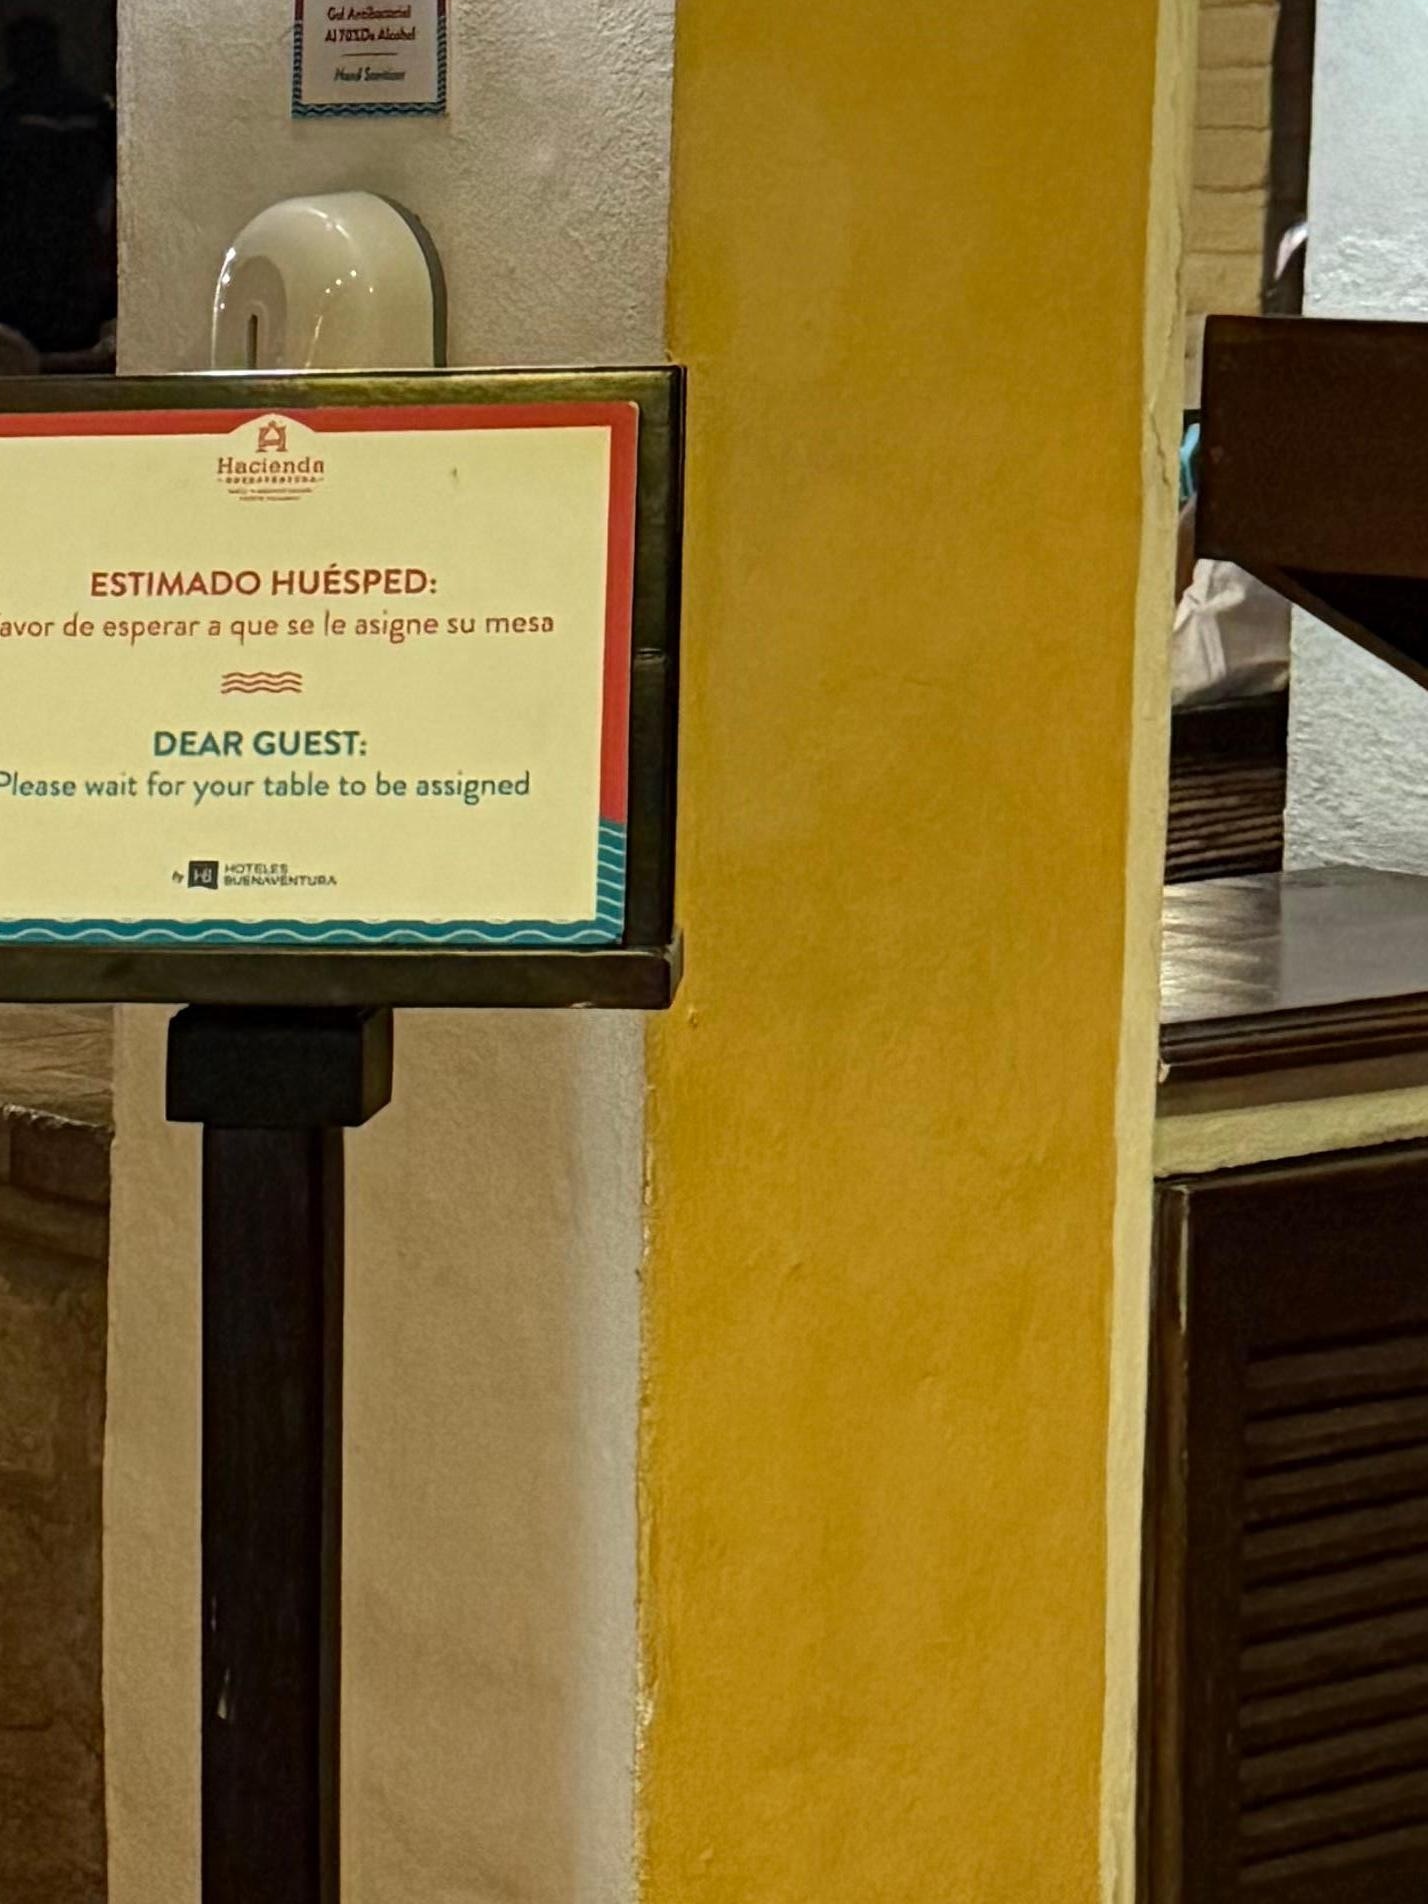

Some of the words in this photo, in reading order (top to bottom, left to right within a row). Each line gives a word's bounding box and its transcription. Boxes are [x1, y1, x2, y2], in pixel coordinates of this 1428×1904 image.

[217, 456, 325, 475] Hacienda
[90, 570, 261, 598] ESTIMADO
[271, 562, 438, 597] HUÉSPED:
[63, 612, 95, 638] de
[102, 619, 201, 647] esperar
[207, 619, 222, 637] a
[230, 619, 280, 647] que
[287, 618, 315, 636] se
[324, 610, 346, 637] le
[354, 610, 440, 645] asigne
[447, 617, 476, 635] su
[485, 615, 555, 634] mesa
[153, 731, 243, 758] DEAR
[252, 730, 368, 757] GUEST:
[84, 771, 139, 798] wait
[147, 771, 186, 798] for
[192, 776, 255, 807] your
[263, 770, 331, 797] table
[338, 775, 367, 797] to
[375, 770, 408, 797] be
[415, 769, 531, 806] assigned
[223, 875, 338, 886] BUENAVENTURA
[224, 863, 288, 874] HOTELES
